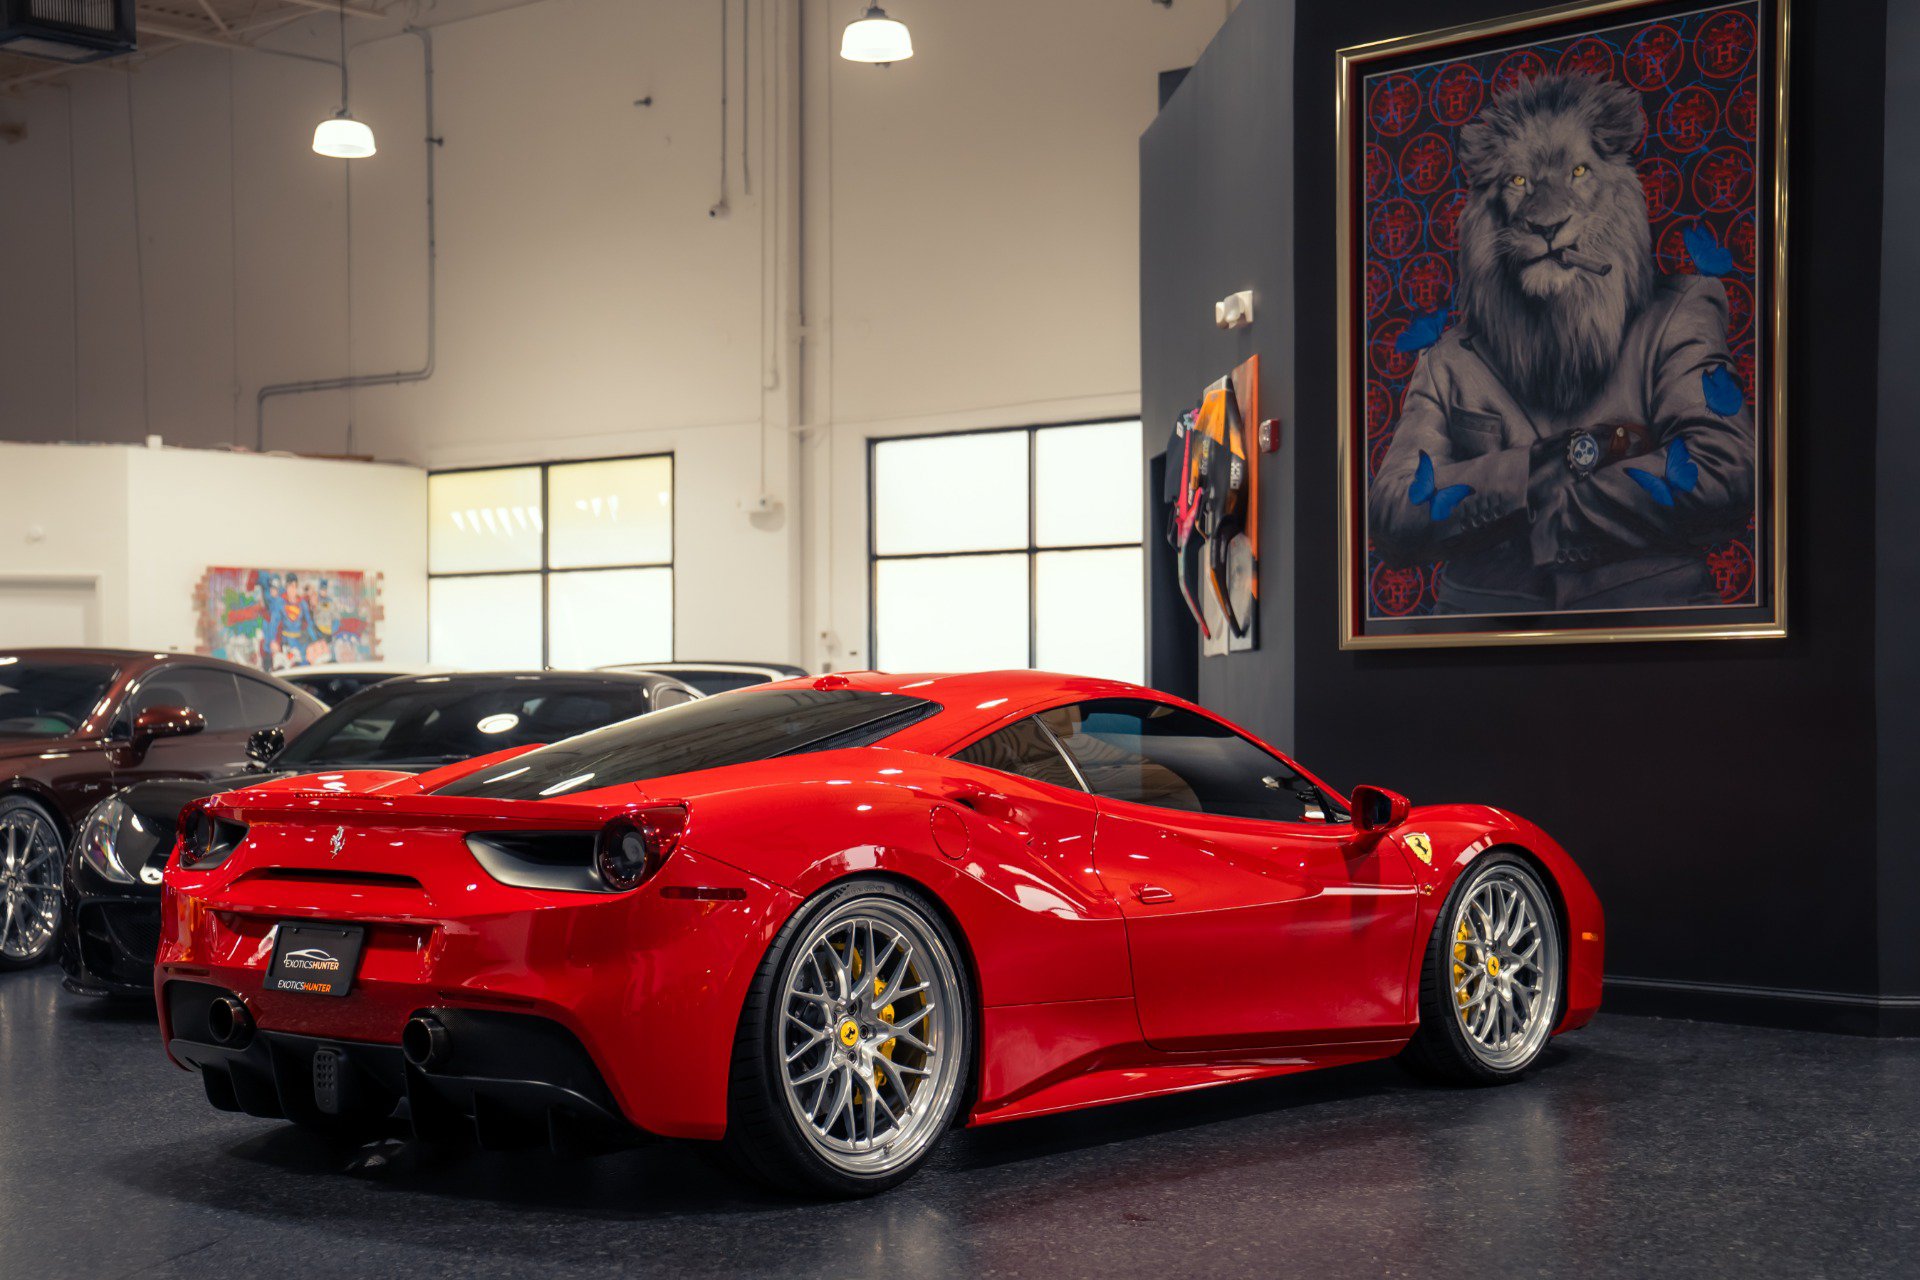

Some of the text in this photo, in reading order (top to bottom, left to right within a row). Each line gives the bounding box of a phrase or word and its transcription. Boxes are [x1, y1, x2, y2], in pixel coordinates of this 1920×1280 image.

[1716, 44, 1734, 64] H
[1646, 58, 1661, 77] H
[1449, 94, 1464, 112] H
[1388, 105, 1403, 126] H
[1679, 118, 1696, 138] H
[1419, 160, 1434, 181] H
[1645, 187, 1660, 207] H
[1715, 178, 1732, 198] H
[1388, 226, 1403, 245] H
[1418, 283, 1434, 299] H
[1716, 570, 1734, 590] H
[1390, 583, 1407, 603] H
[285, 960, 339, 971] EXOTICSHUNTER
[278, 979, 331, 993] EXOTICSHUNTER
